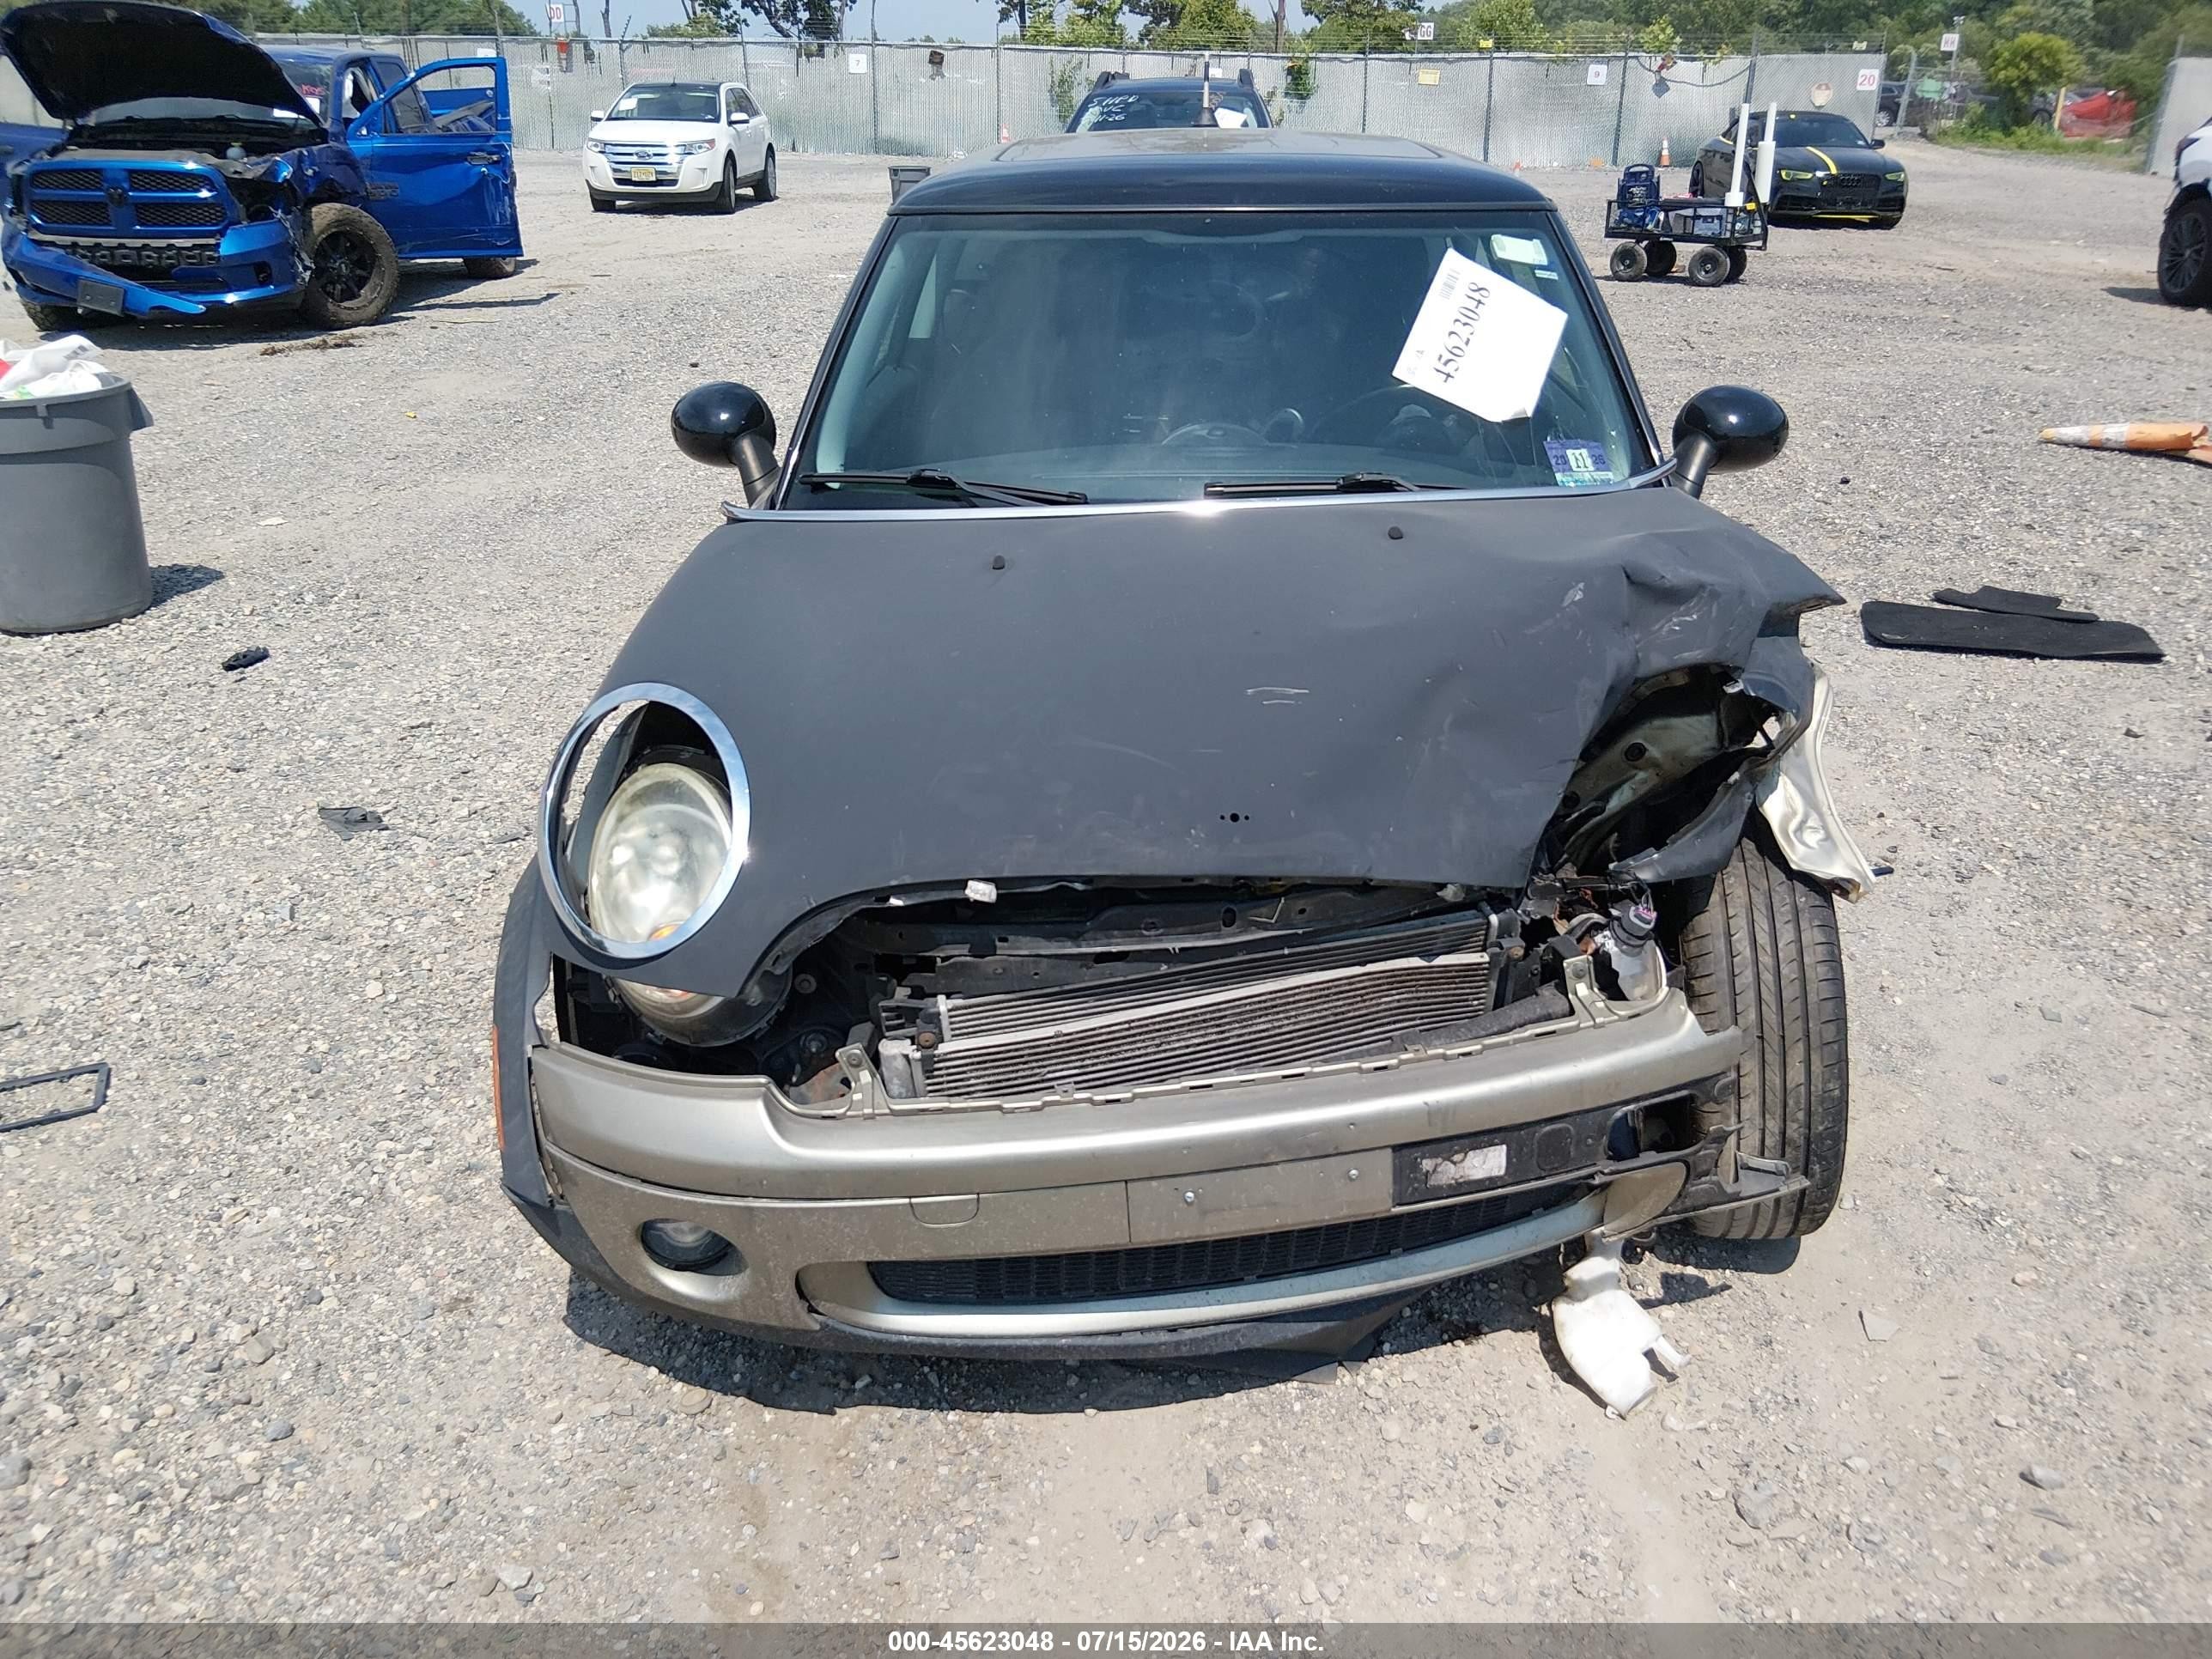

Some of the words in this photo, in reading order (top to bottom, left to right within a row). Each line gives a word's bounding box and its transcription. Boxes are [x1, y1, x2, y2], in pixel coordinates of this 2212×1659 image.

[1419, 25, 1432, 38] GG
[1859, 74, 1875, 87] 20
[1433, 282, 1491, 383] 45623048
[1553, 454, 1568, 465] 20
